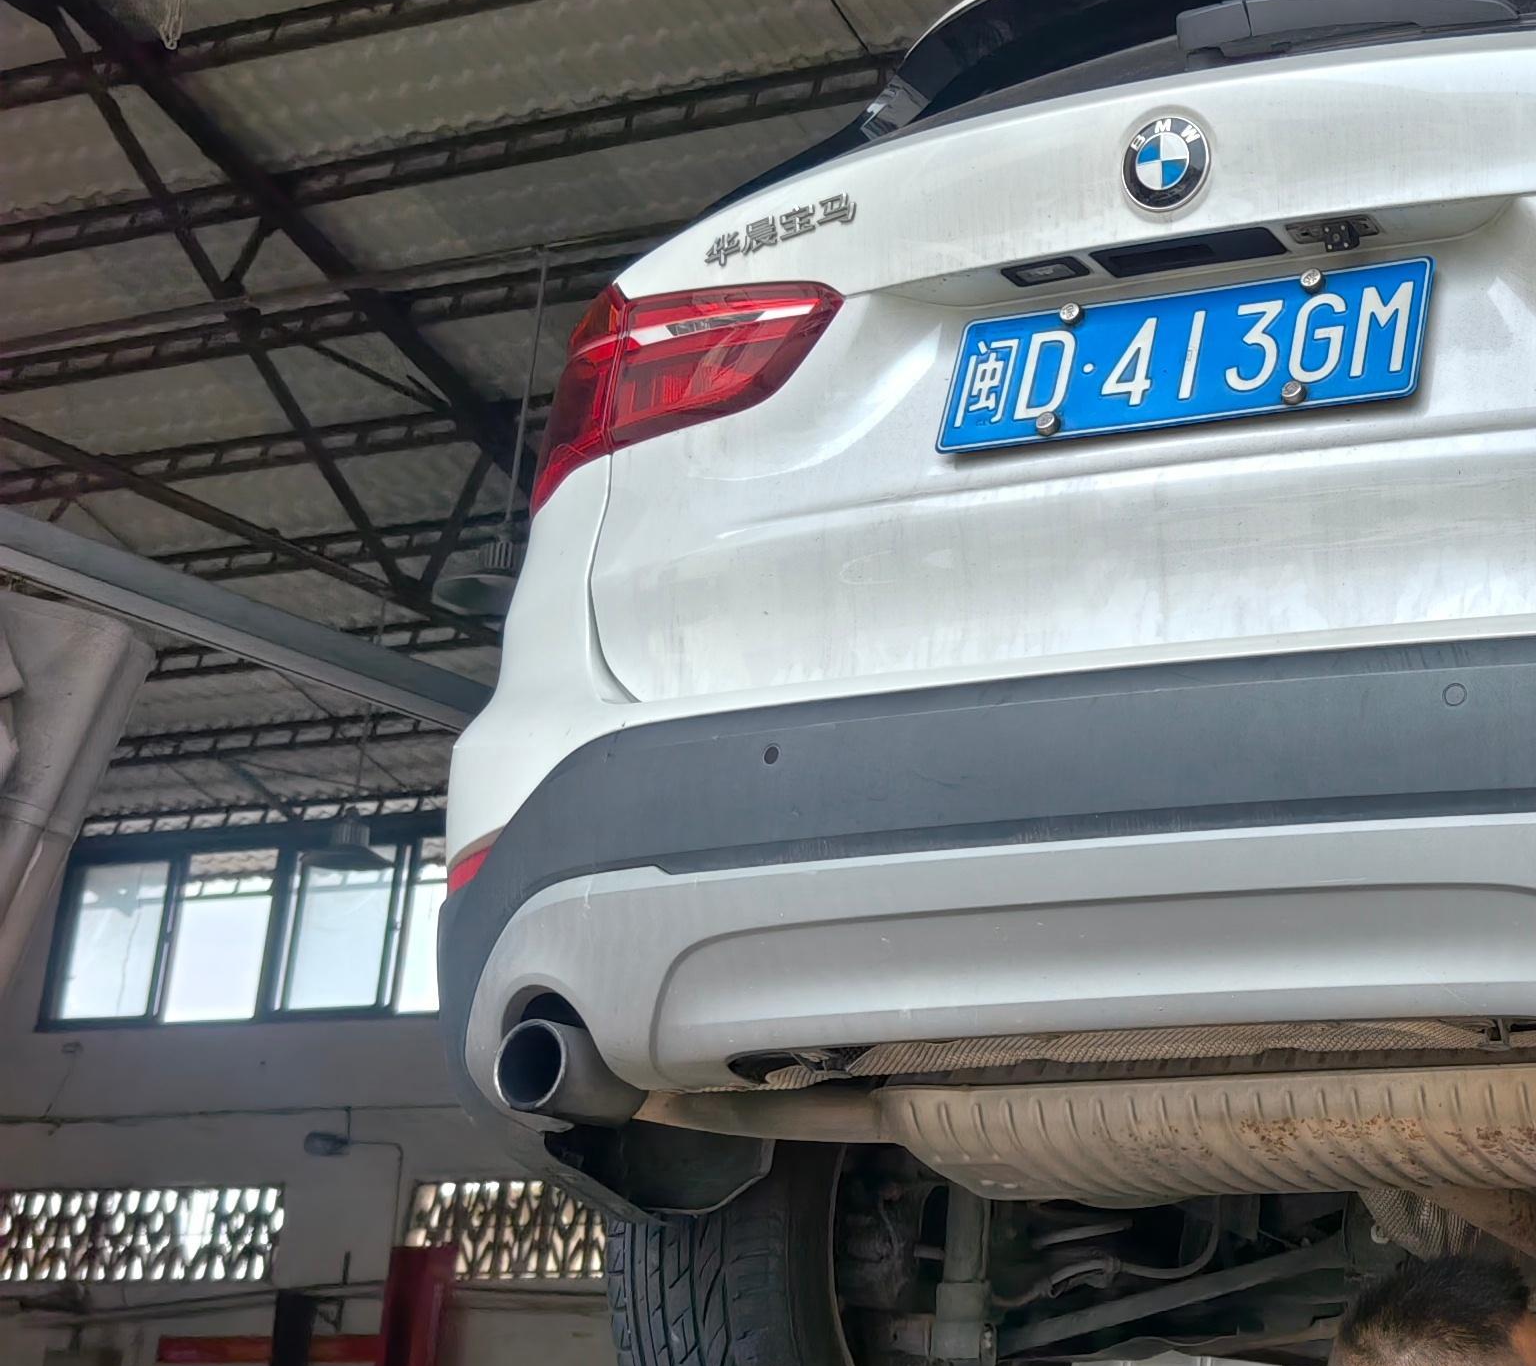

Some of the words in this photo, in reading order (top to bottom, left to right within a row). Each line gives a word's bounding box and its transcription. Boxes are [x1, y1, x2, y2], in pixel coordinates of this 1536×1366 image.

[1130, 118, 1201, 152] BMW
[704, 188, 857, 267] 华晨宝马
